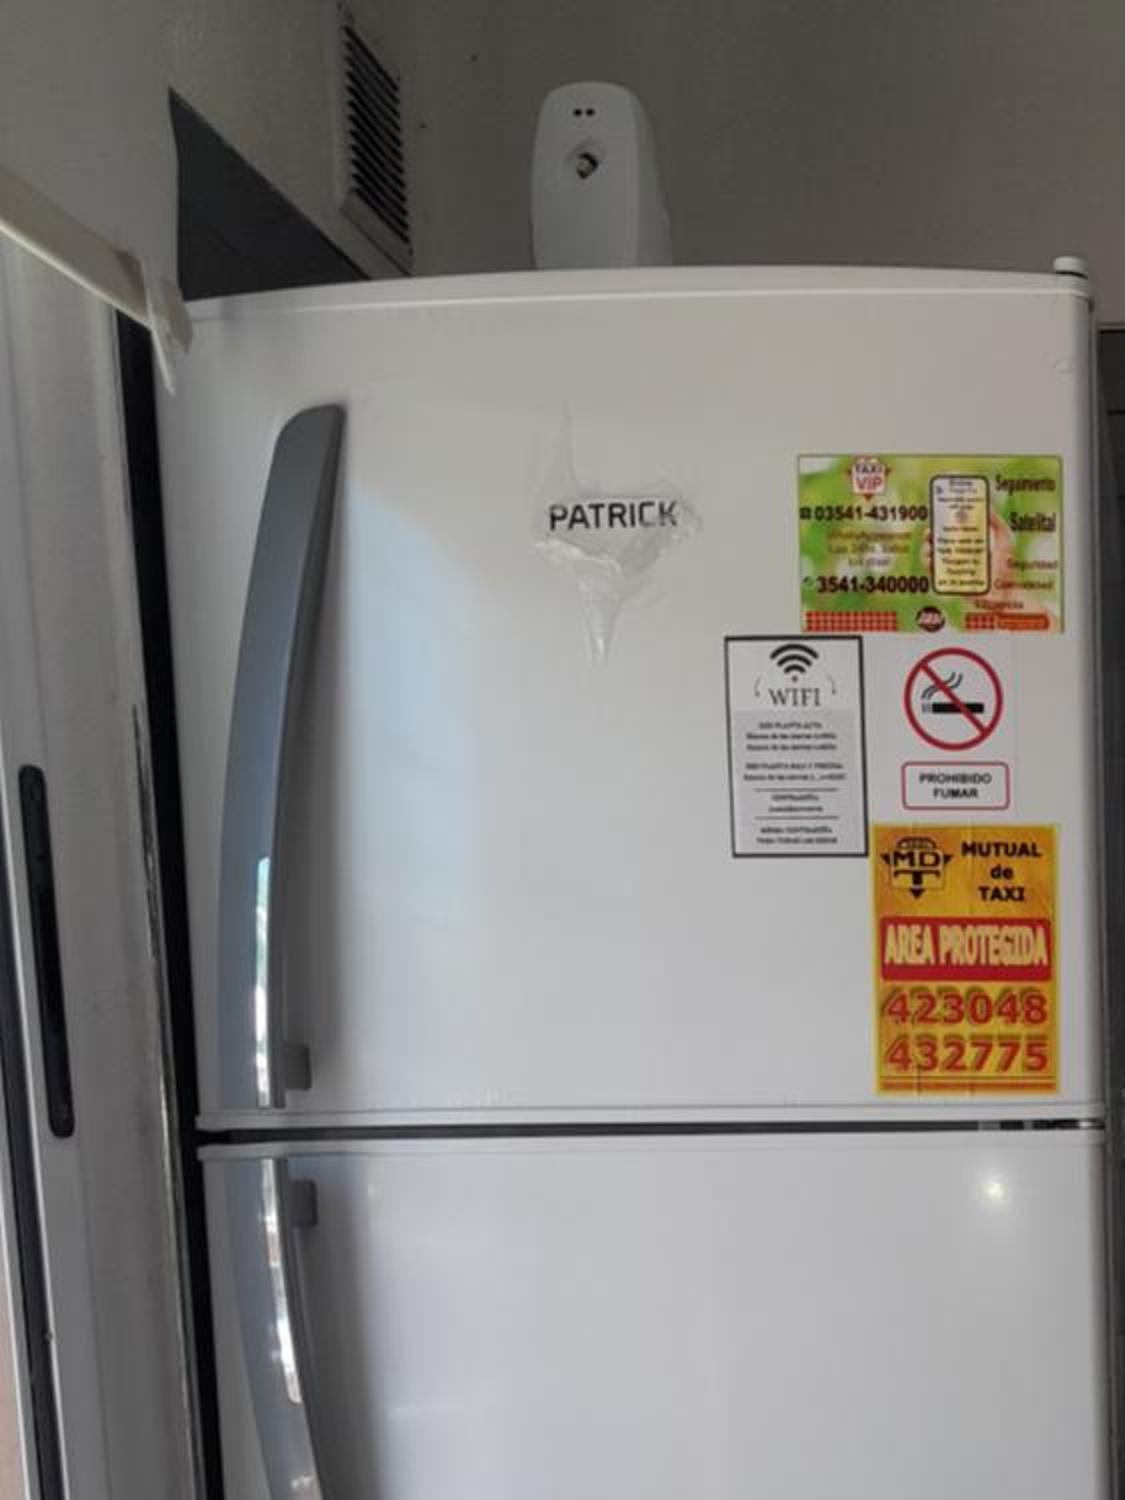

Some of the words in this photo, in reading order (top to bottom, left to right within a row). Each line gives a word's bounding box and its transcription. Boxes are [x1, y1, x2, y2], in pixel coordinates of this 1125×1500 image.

[855, 476, 883, 490] VIP
[548, 499, 679, 532] PATRICK
[815, 505, 929, 521] 03541-431900
[817, 575, 930, 593] 3541-340000
[769, 688, 820, 706] WIFI
[919, 772, 992, 785] PROHIBIDO
[933, 787, 979, 799] FUMAR
[961, 841, 1043, 858] MUTUAL
[990, 864, 1015, 880] de
[978, 886, 1026, 902] TAXI
[885, 924, 935, 966] AREA
[939, 924, 1048, 967] PROTEGIDA
[884, 987, 1048, 1025] 423048
[885, 1035, 1048, 1073] 432775
